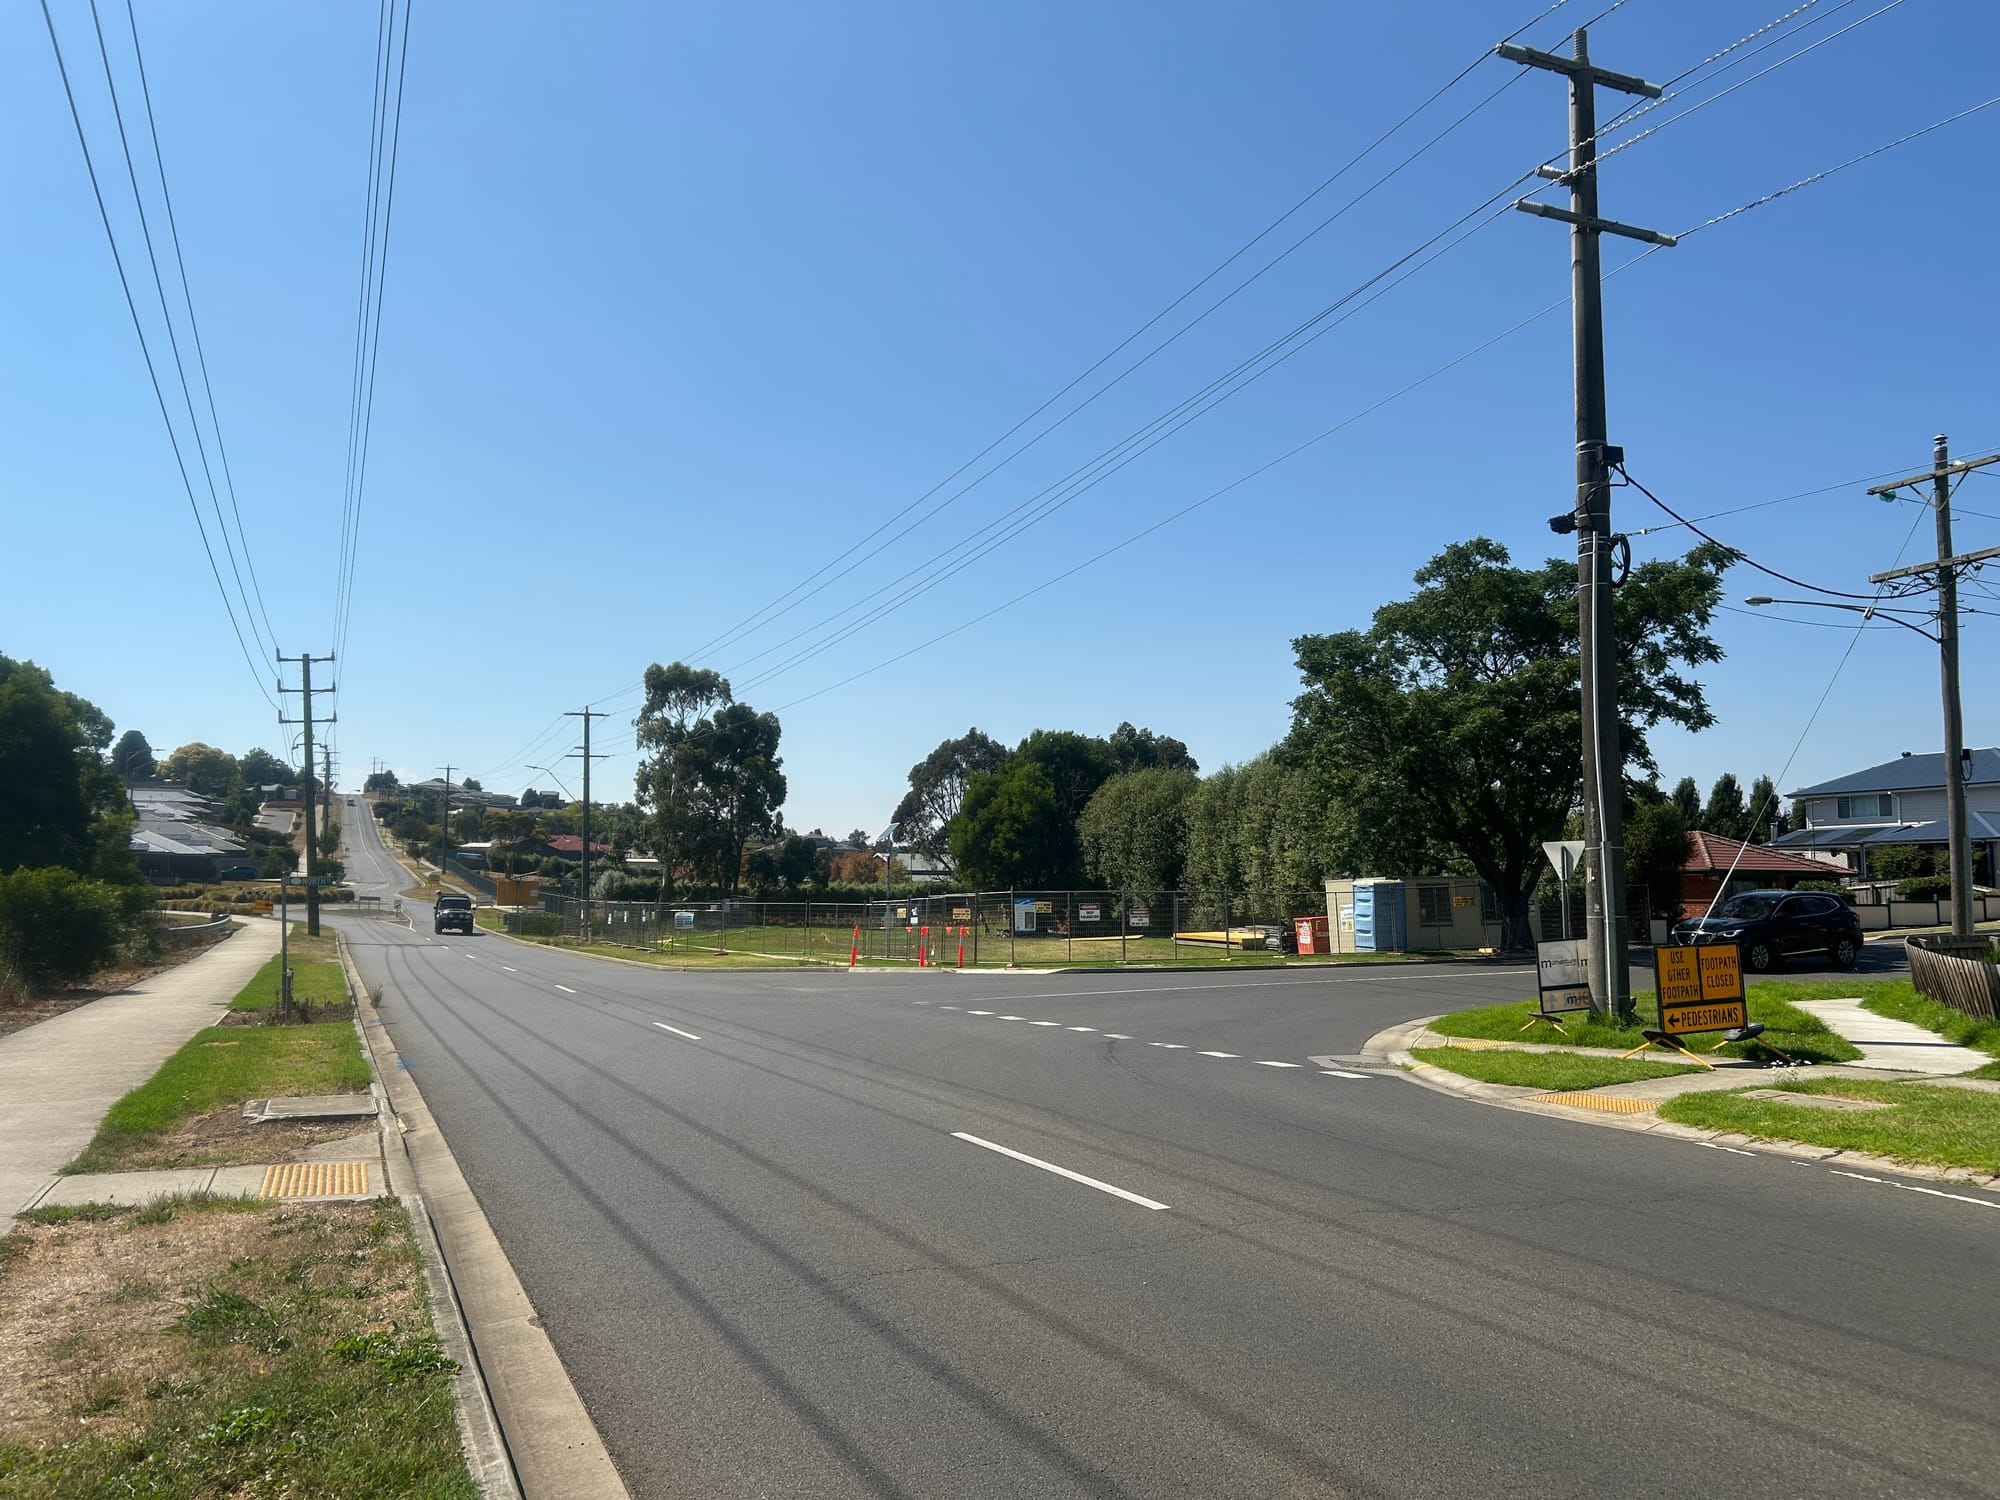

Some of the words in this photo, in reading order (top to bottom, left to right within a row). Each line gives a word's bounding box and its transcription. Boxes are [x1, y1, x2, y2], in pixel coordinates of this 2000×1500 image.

[1670, 951, 1685, 964] USE
[1700, 955, 1737, 971] FOOTPATH
[1667, 968, 1691, 982] OTHER
[1706, 973, 1734, 988] CLOSED
[1662, 984, 1699, 1000] FOOTPATH
[1681, 1007, 1739, 1028] PEDESTRIANS
